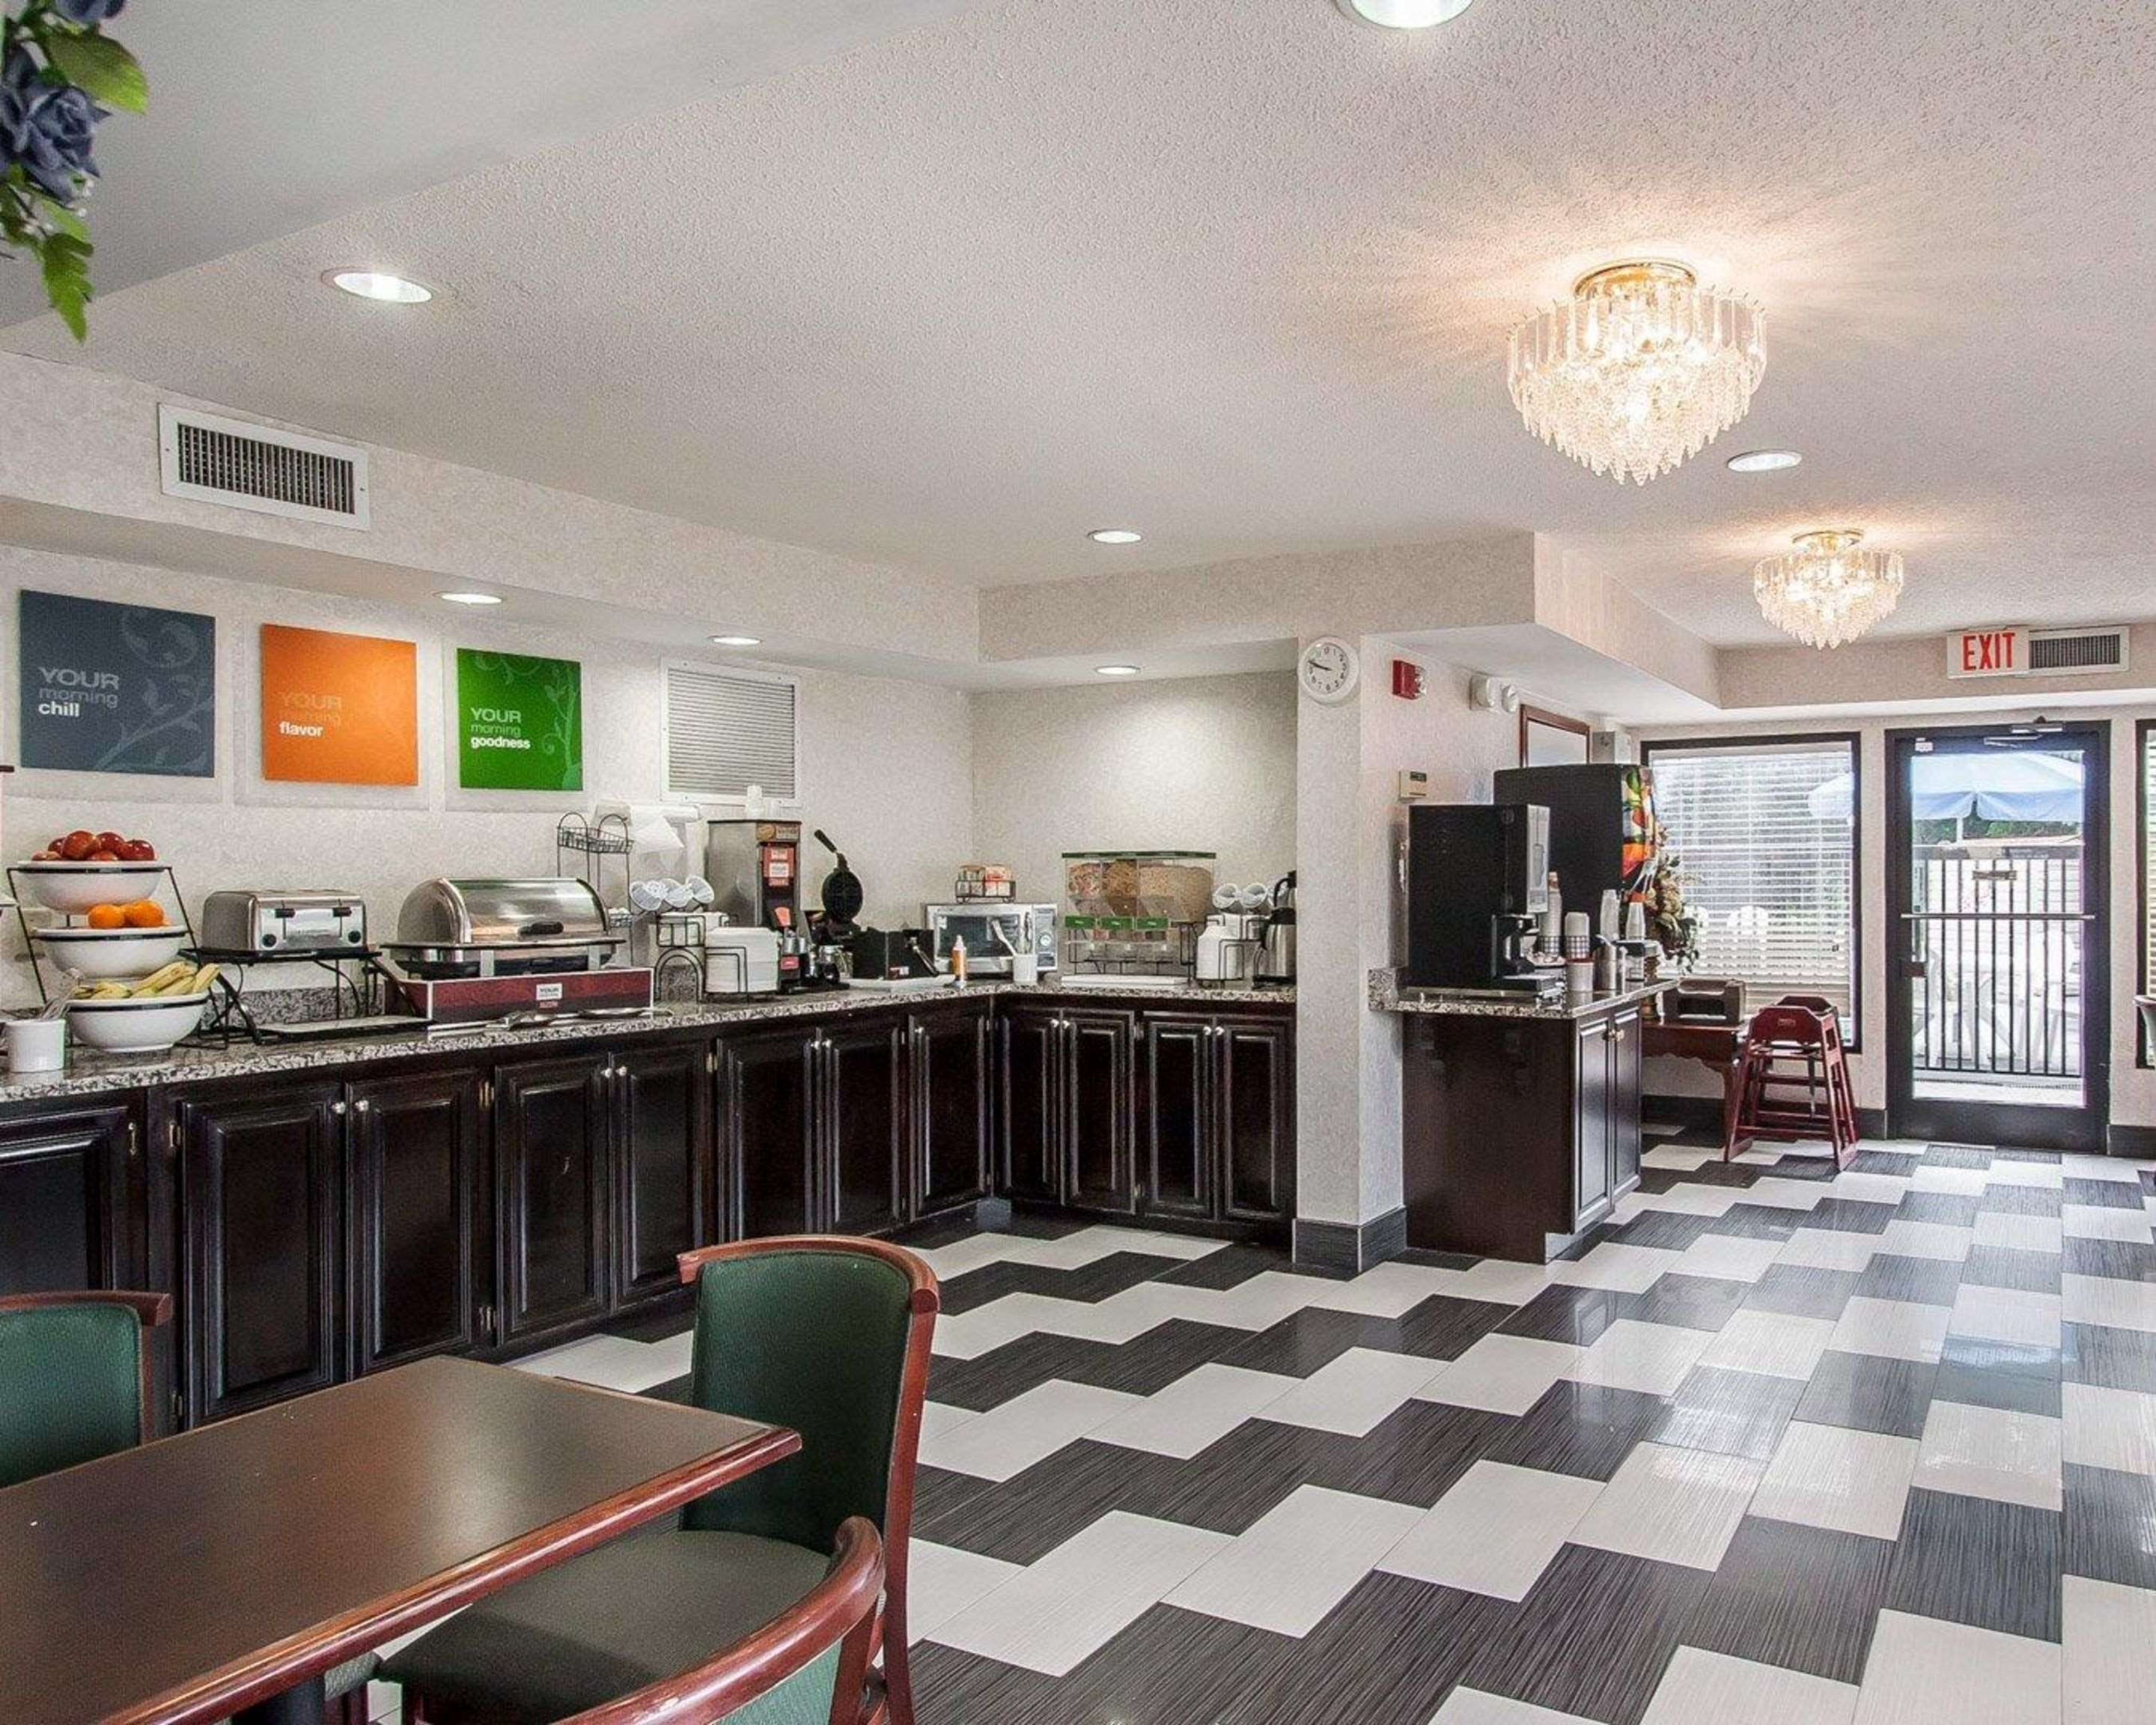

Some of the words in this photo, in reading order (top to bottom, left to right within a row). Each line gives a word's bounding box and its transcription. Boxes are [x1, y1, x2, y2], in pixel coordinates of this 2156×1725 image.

[1963, 633, 2015, 671] EXIT
[38, 666, 120, 690] YOUR
[39, 687, 118, 708] morning
[276, 691, 342, 710] YOUR
[37, 701, 80, 717] chill
[470, 708, 522, 723] YOUR
[278, 721, 323, 737] flavor
[471, 723, 521, 737] morning
[470, 737, 531, 749] goodness
